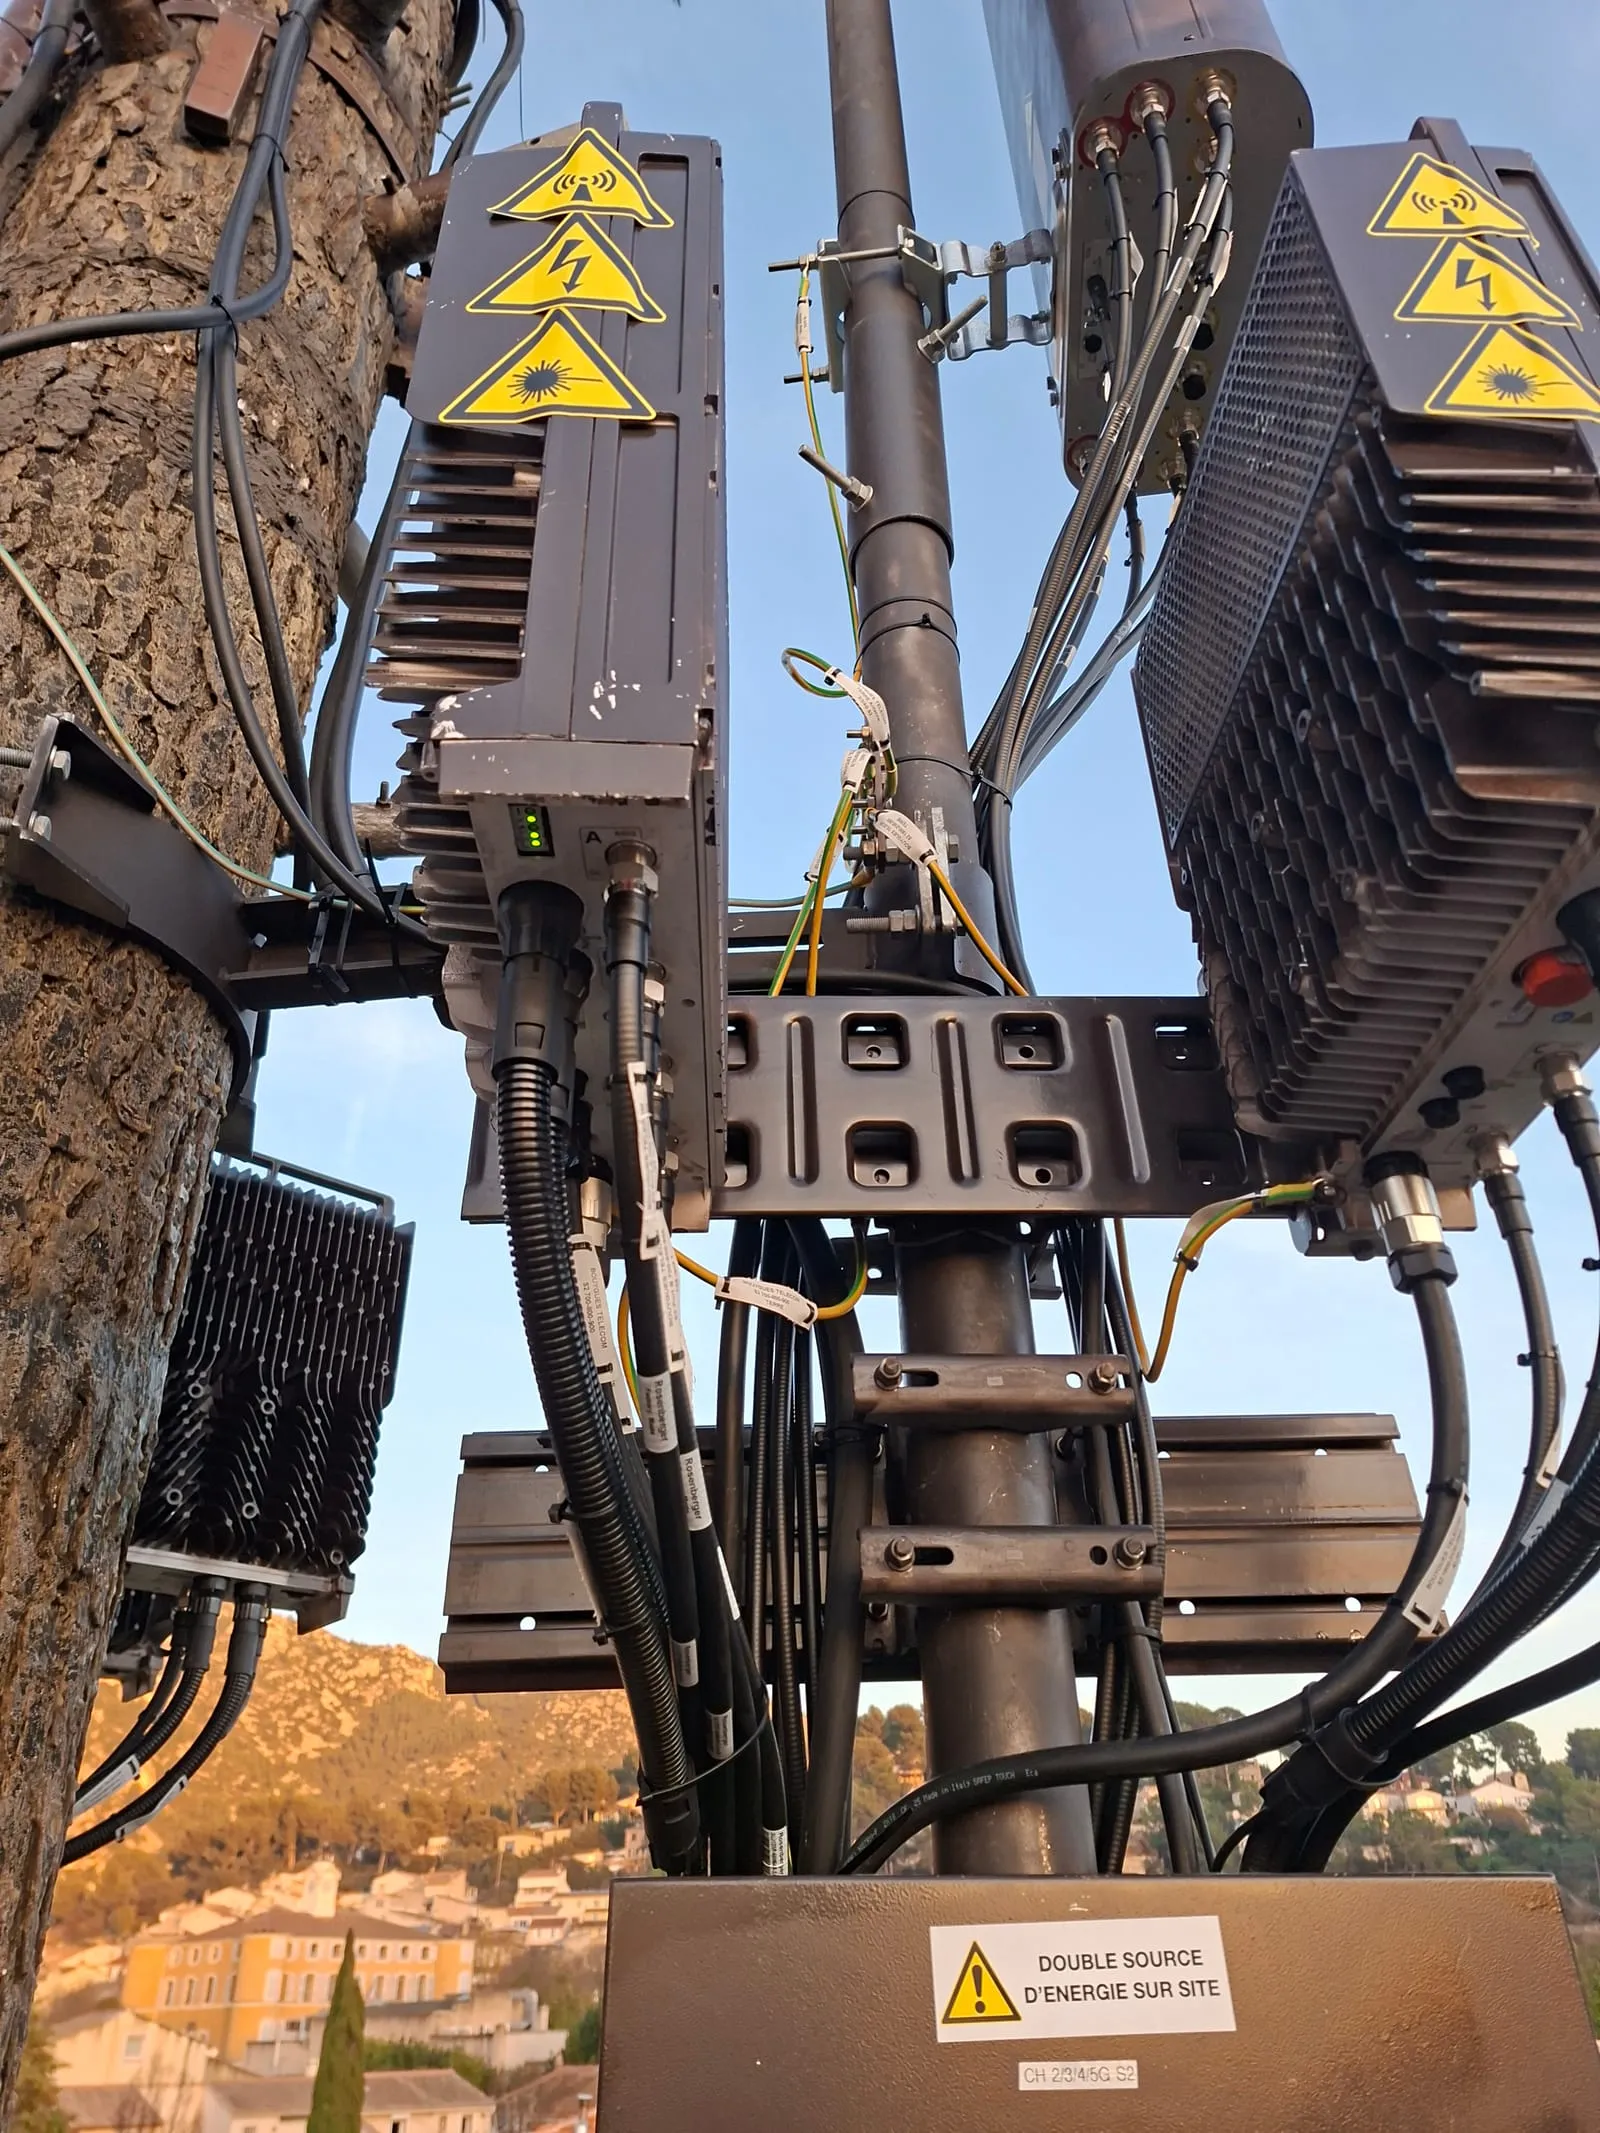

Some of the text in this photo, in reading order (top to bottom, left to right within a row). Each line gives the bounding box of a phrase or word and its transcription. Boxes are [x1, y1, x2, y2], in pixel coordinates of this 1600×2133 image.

[586, 831, 602, 844] A
[589, 1266, 607, 1348] BOUYGUES TELECOM
[653, 1379, 668, 1441] Rosenberger
[685, 1457, 701, 1520] Rosenberger
[1038, 1949, 1204, 1972] DOUBLE SOURCE
[1024, 1979, 1221, 2004] D'ENERGIE SUR SITE
[1024, 2065, 1136, 2083] CH 2/3/4/5G S2
